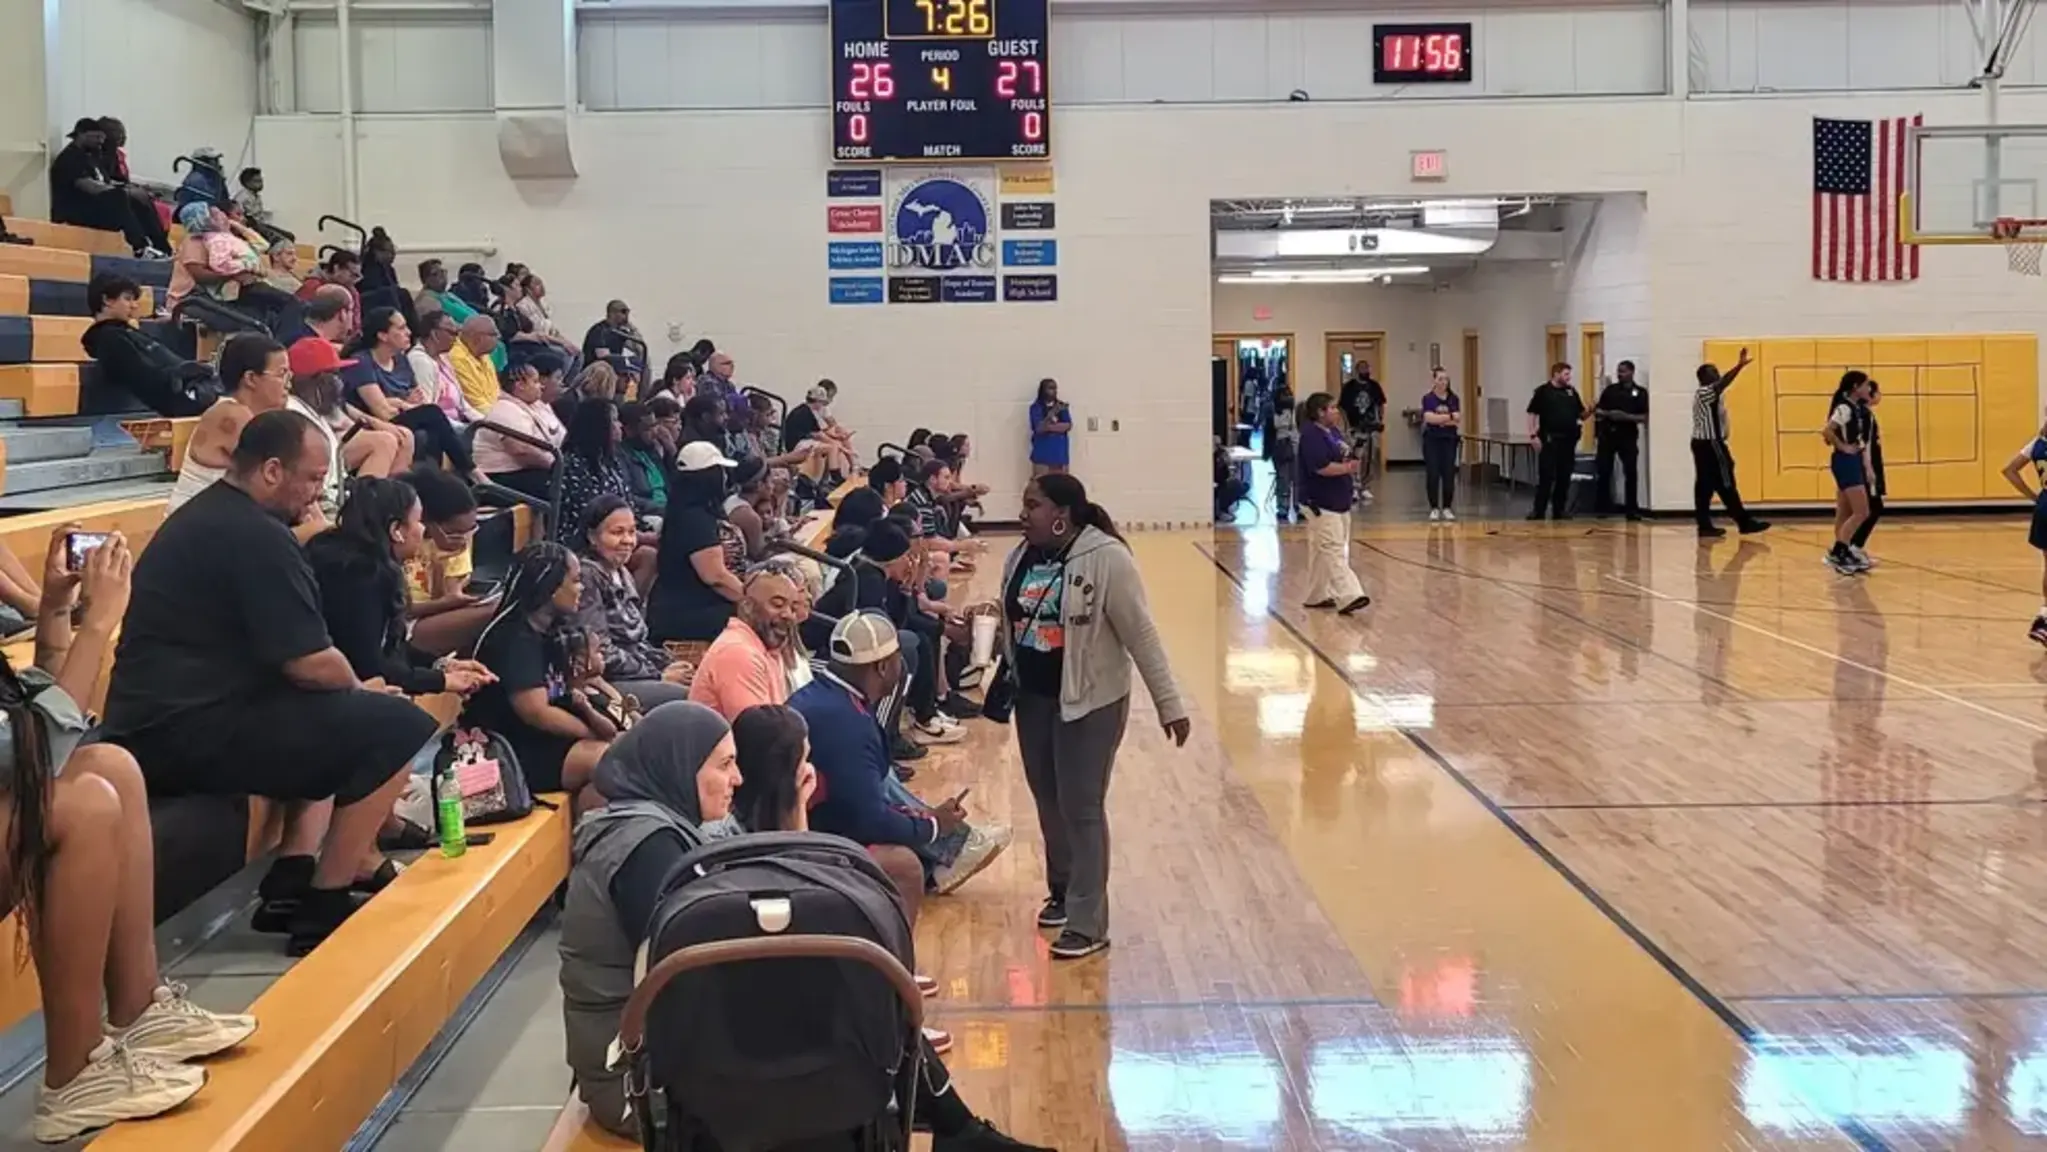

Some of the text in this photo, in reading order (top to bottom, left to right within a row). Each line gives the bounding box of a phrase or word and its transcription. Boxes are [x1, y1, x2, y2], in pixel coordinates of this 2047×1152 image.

[916, 0, 989, 34] 7:26
[844, 41, 890, 59] HOME
[921, 49, 960, 62] PERIOD
[988, 40, 1039, 57] GUEST
[1394, 34, 1461, 71] 11:56
[850, 63, 894, 98] 26
[931, 67, 949, 92] 4
[997, 61, 1041, 95] 27
[836, 100, 871, 113] FOULS
[907, 99, 977, 112] PLAYER FOUL
[1010, 98, 1045, 111] FOULS
[850, 114, 868, 142] 0
[1024, 112, 1042, 139] 0
[837, 146, 872, 158] SCORE
[924, 144, 961, 157] MATCH
[1012, 143, 1046, 155] SCORE
[888, 243, 994, 268] DMAC
